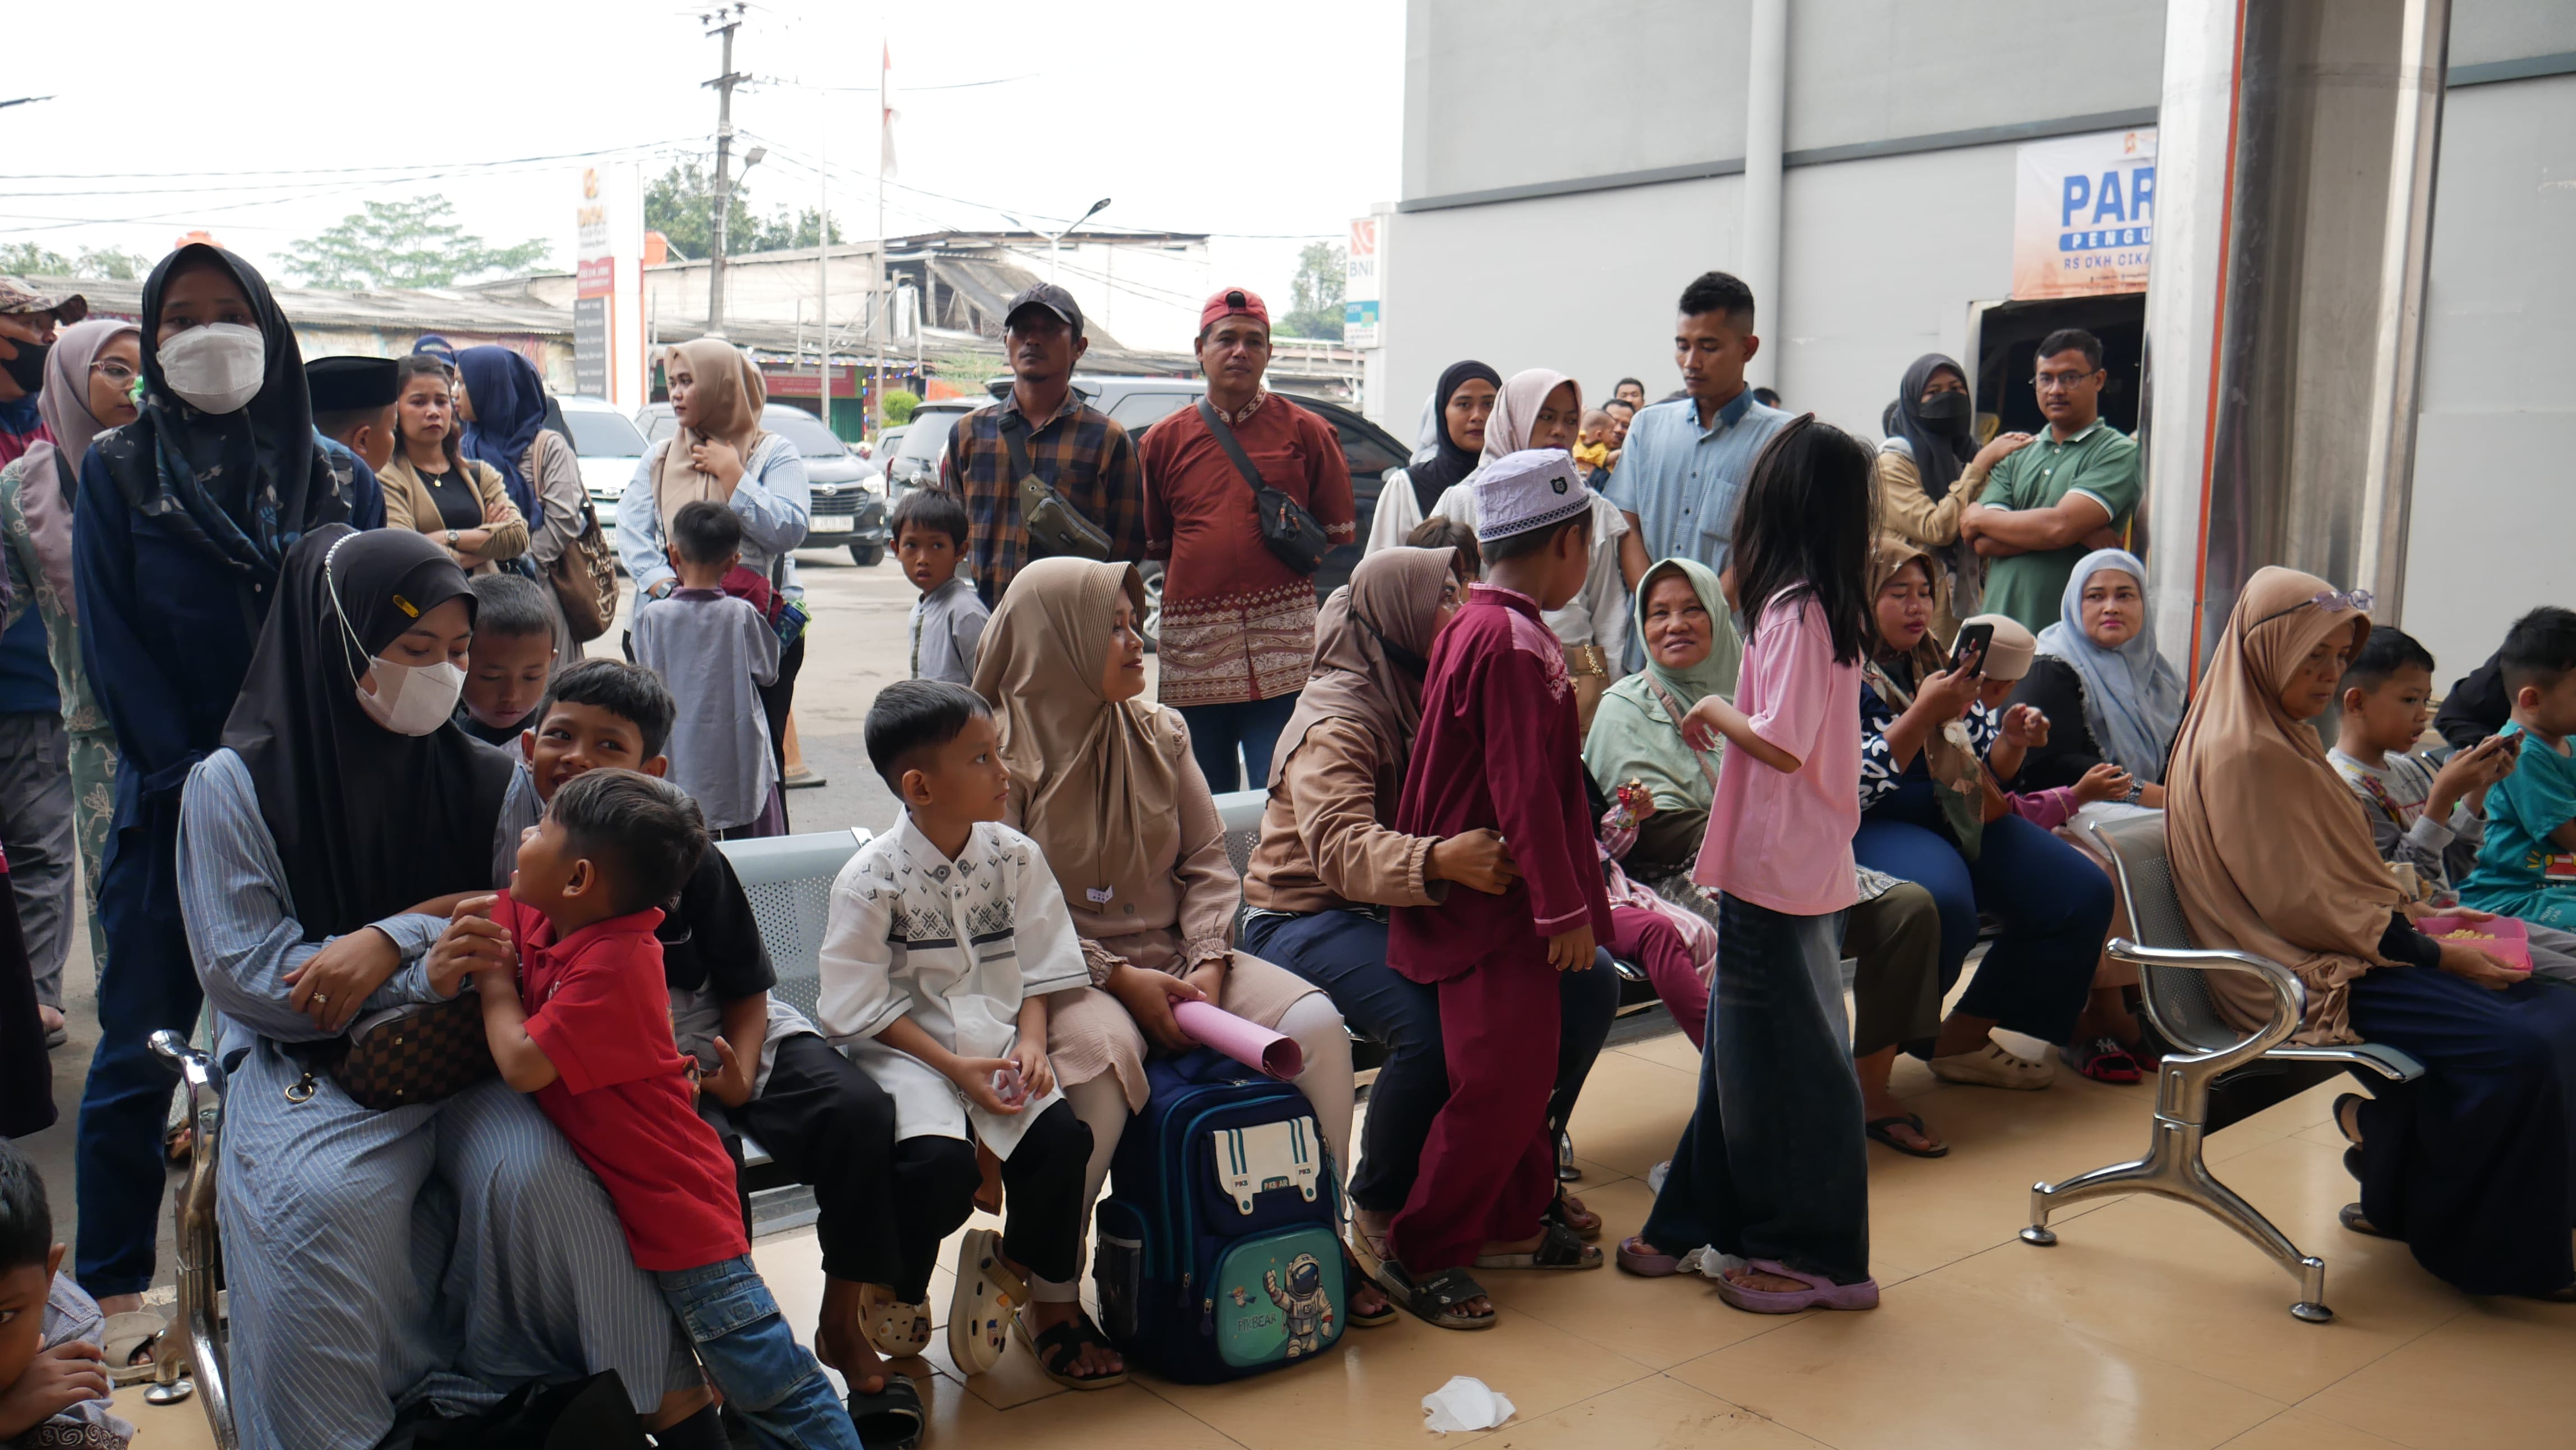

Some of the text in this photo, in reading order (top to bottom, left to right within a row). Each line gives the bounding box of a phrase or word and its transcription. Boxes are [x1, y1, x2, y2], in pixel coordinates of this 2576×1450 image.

[2072, 228, 2151, 249] PENGU
[1350, 260, 1374, 277] BNI
[2064, 258, 2080, 269] RS
[1346, 305, 1362, 314] ATM
[1238, 1311, 1277, 1333] PIKBEAR
